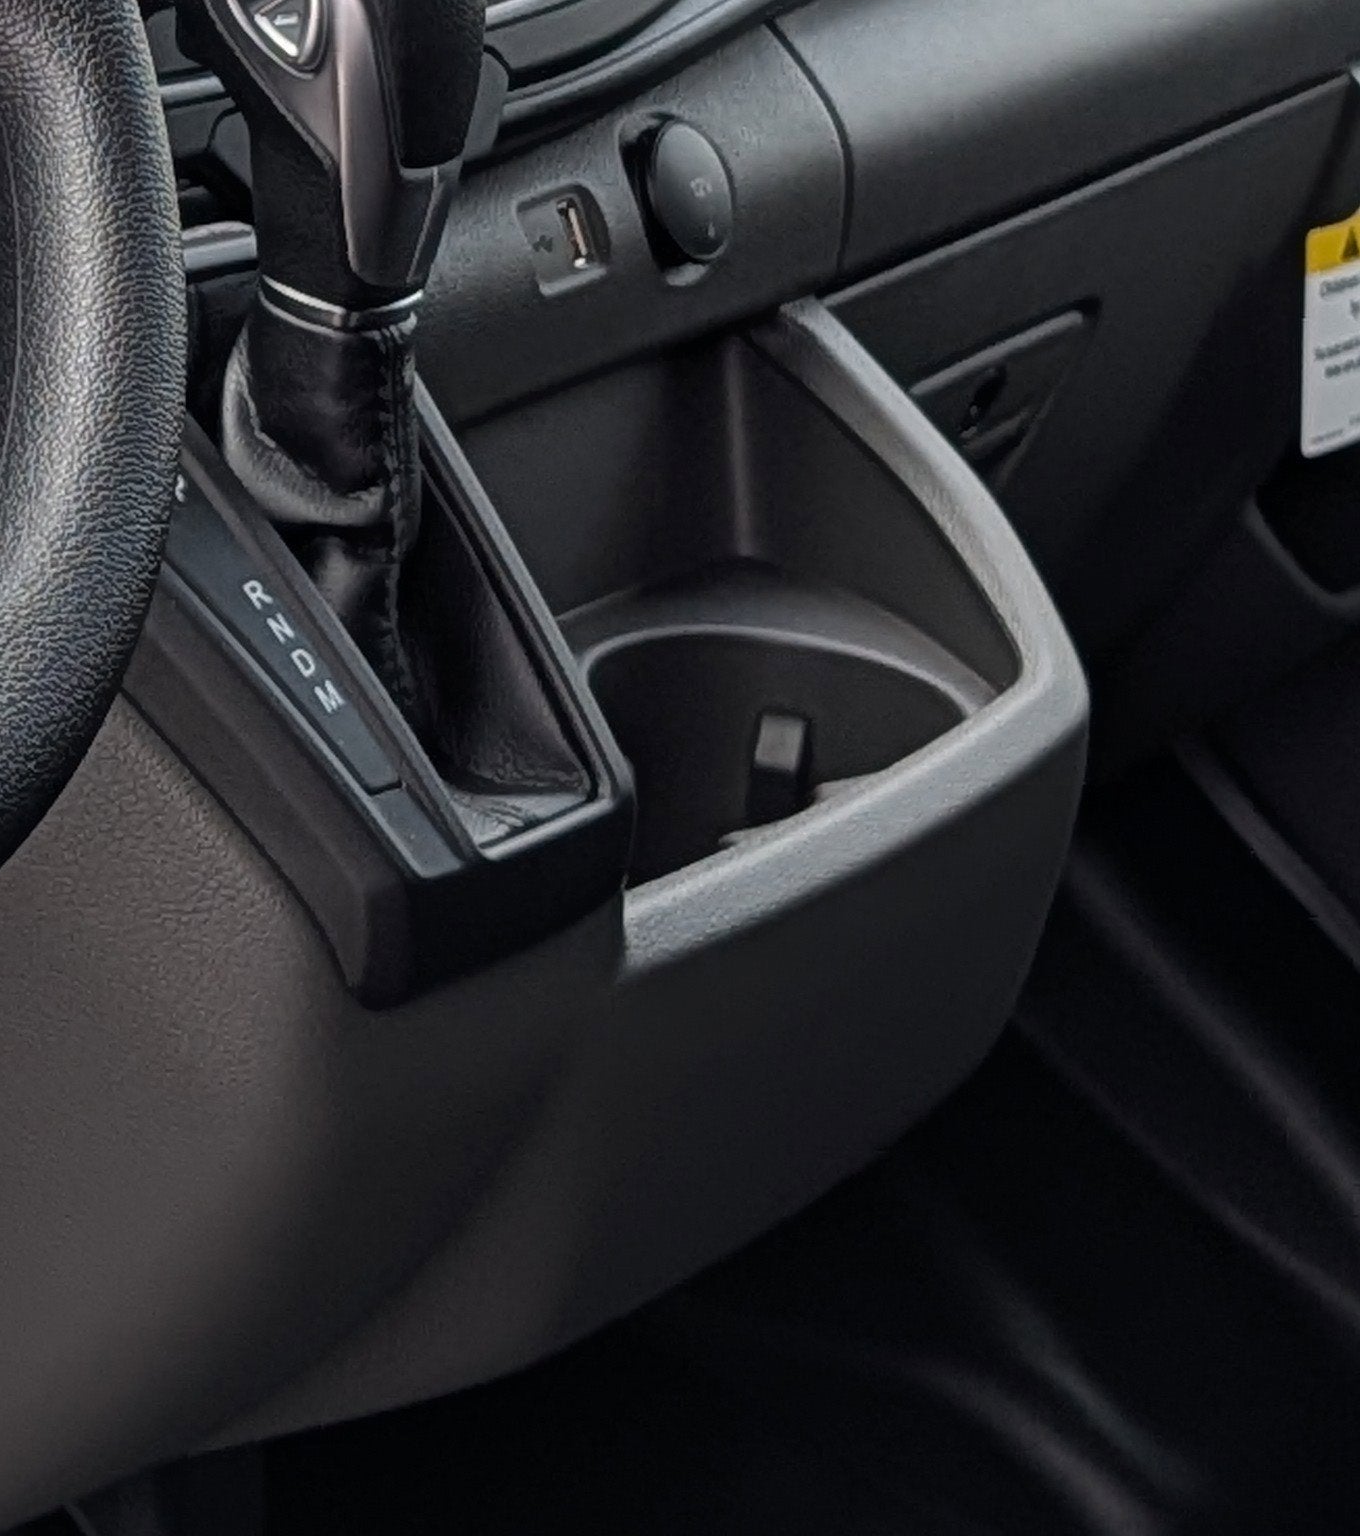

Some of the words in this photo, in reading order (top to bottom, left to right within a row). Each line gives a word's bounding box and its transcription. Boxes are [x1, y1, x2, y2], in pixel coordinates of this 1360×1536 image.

[242, 579, 273, 611] R
[266, 613, 296, 645] N
[290, 648, 317, 678] D
[314, 679, 347, 714] M
